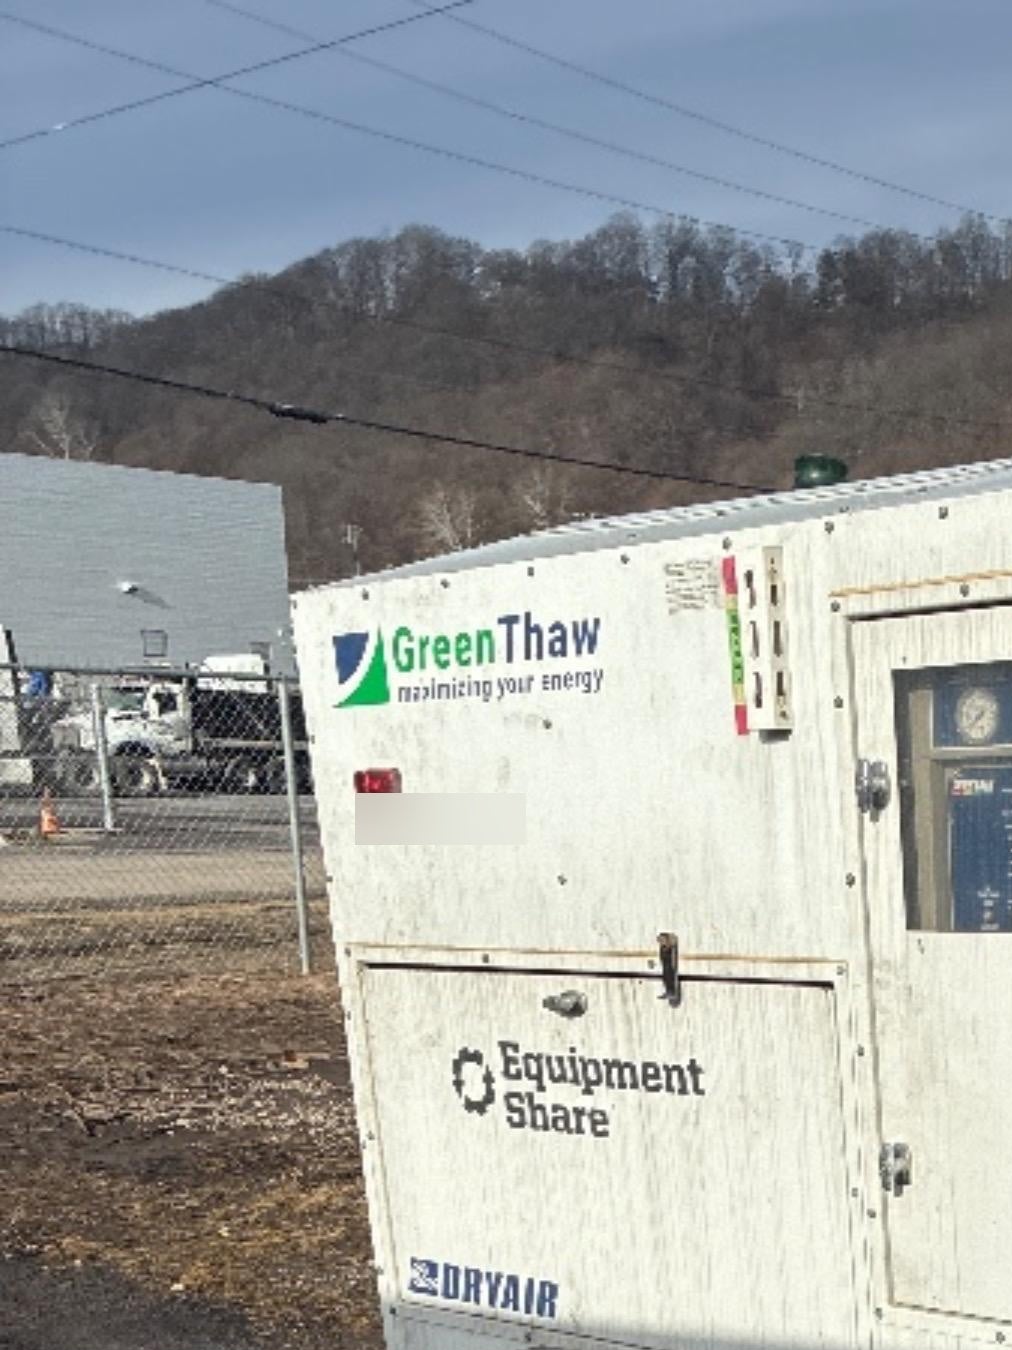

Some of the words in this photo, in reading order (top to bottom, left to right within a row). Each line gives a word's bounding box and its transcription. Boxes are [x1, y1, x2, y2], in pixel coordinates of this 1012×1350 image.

[398, 675, 493, 702] maximizing
[497, 674, 535, 700] your
[542, 669, 604, 694] energy
[498, 1041, 705, 1096] Equipment
[504, 1091, 609, 1137] Share
[441, 1262, 559, 1318] DRYAIR
